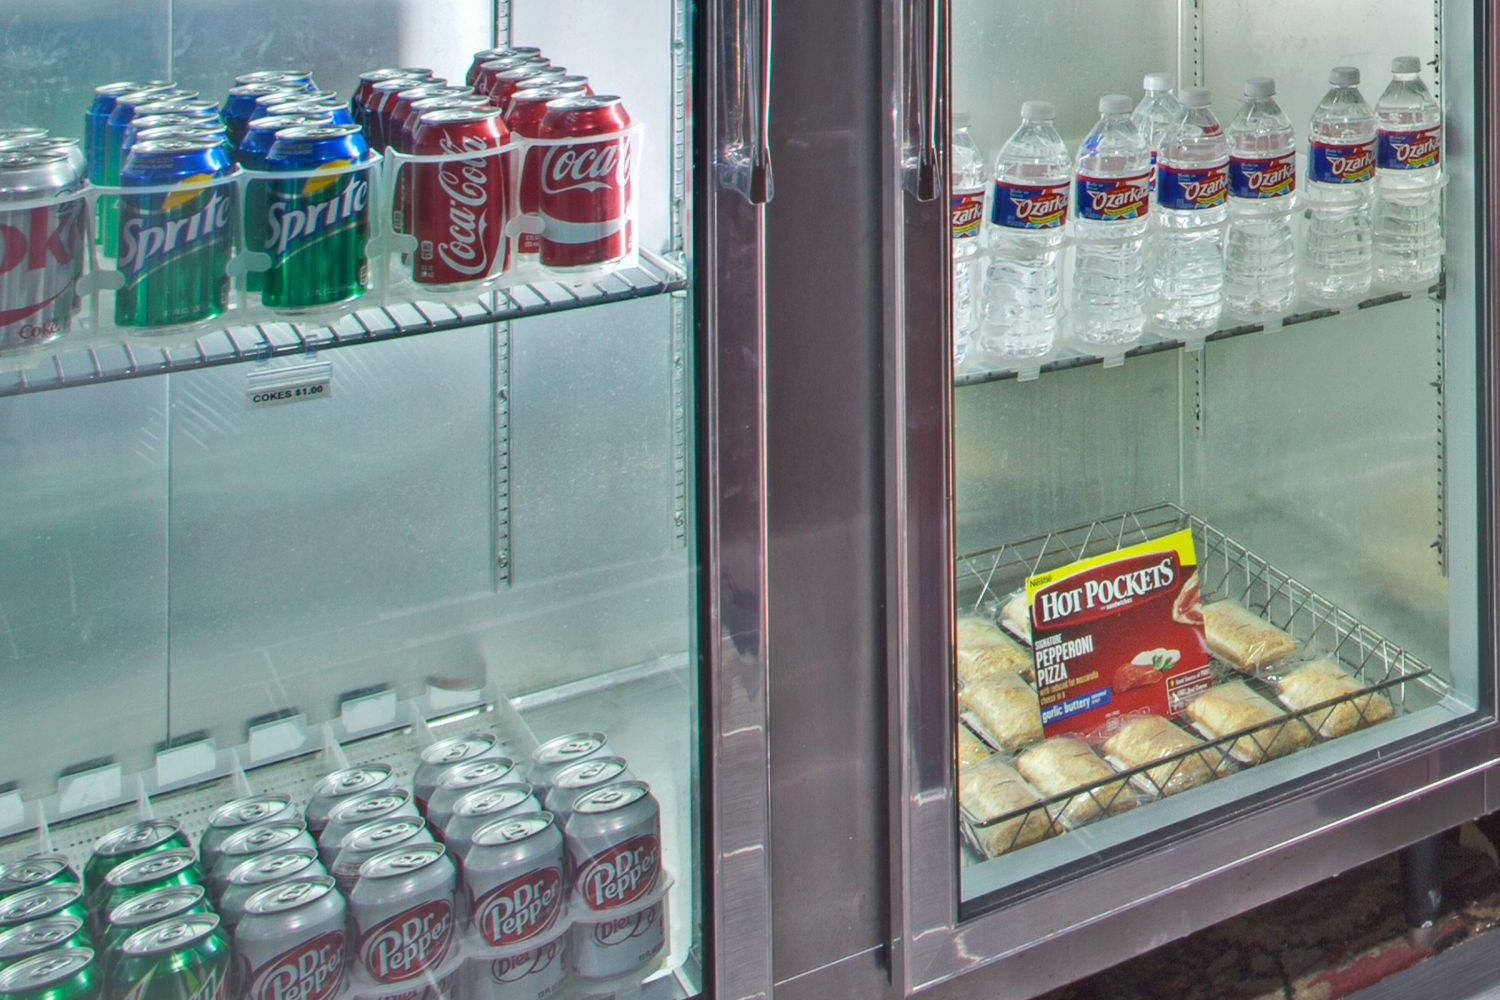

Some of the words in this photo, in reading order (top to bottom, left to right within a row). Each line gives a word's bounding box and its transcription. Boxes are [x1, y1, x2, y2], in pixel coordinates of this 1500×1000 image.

[263, 172, 369, 256] Sprite
[437, 128, 489, 275] Coca-Cola
[117, 190, 231, 275] Sprite
[18, 320, 60, 341] Coke
[252, 389, 292, 404] COKES
[295, 384, 324, 399] $1.00
[1041, 588, 1083, 623] HOT
[1084, 557, 1175, 610] POCKETS
[1036, 634, 1094, 670] PEPPERONI
[1037, 662, 1068, 689] PIZZA
[1042, 704, 1064, 724] garlic
[1063, 696, 1092, 715] buttery
[591, 846, 658, 908] Pepper
[615, 841, 644, 878] Dr
[490, 879, 560, 944] Pepper
[512, 878, 545, 914] Dr
[377, 915, 450, 978] Pepper
[402, 911, 435, 949] Dr
[264, 944, 343, 1000] Pepper
[299, 940, 331, 981] Dr
